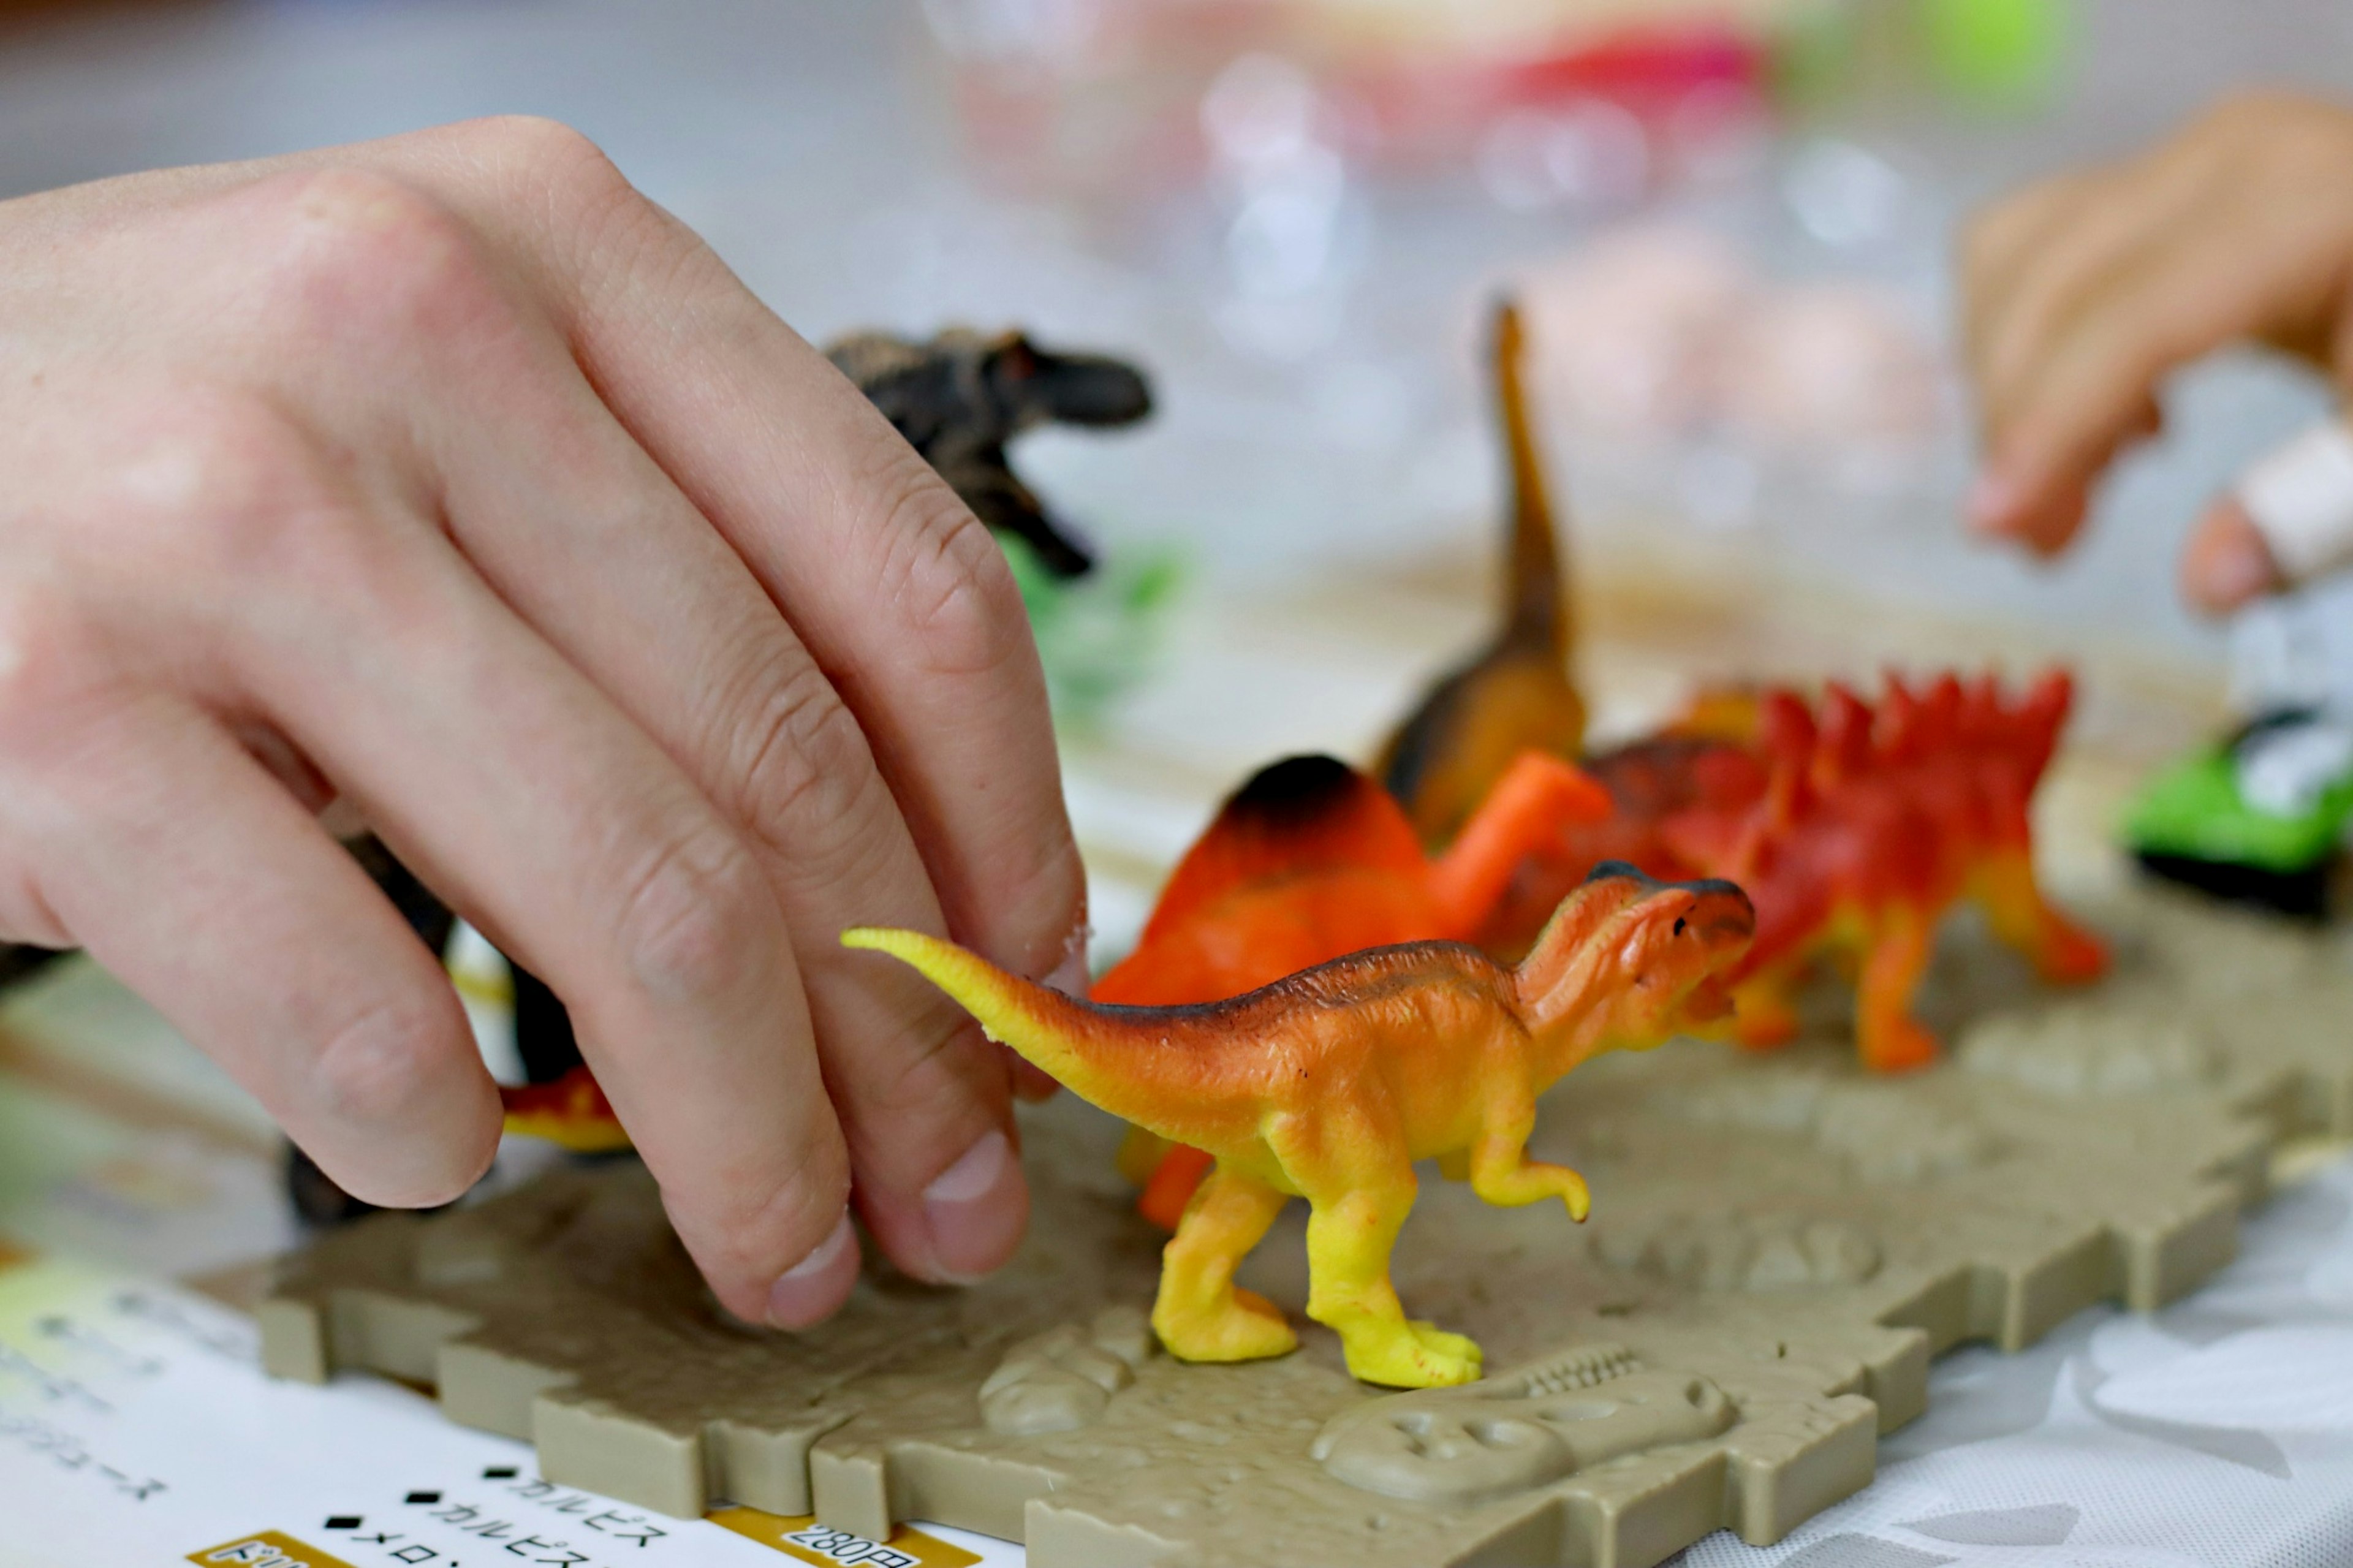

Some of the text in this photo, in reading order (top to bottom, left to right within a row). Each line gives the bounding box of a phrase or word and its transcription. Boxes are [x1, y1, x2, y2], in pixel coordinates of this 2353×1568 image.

[506, 1479, 668, 1547] カルピス
[350, 1533, 458, 1568] メロ
[789, 1524, 913, 1568] 280円
